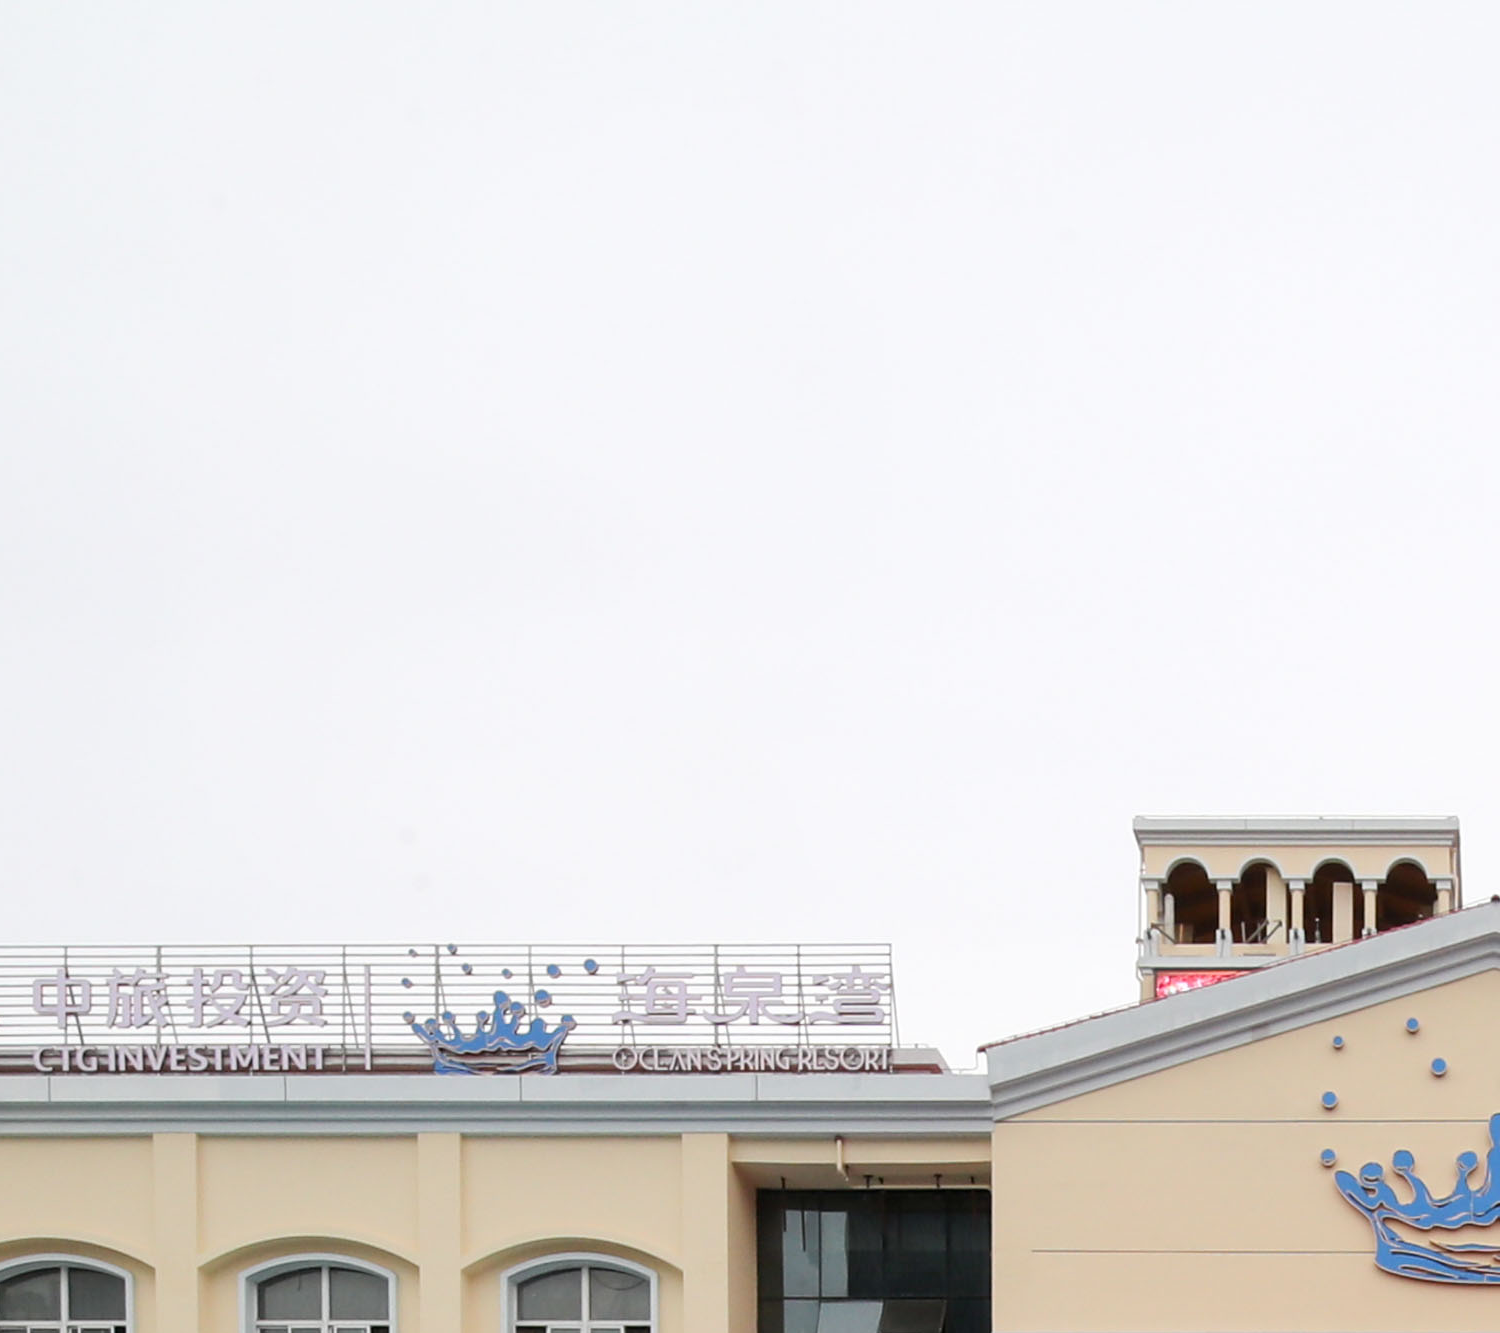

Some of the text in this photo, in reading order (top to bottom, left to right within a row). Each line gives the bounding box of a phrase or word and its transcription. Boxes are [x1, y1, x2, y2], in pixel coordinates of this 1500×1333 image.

[32, 967, 328, 1029] 中旅投资
[612, 965, 892, 1025] 海泉湾
[33, 1045, 325, 1073] CTG INVESTMENT
[612, 1046, 890, 1073] OCEAN SPRING RESORT
